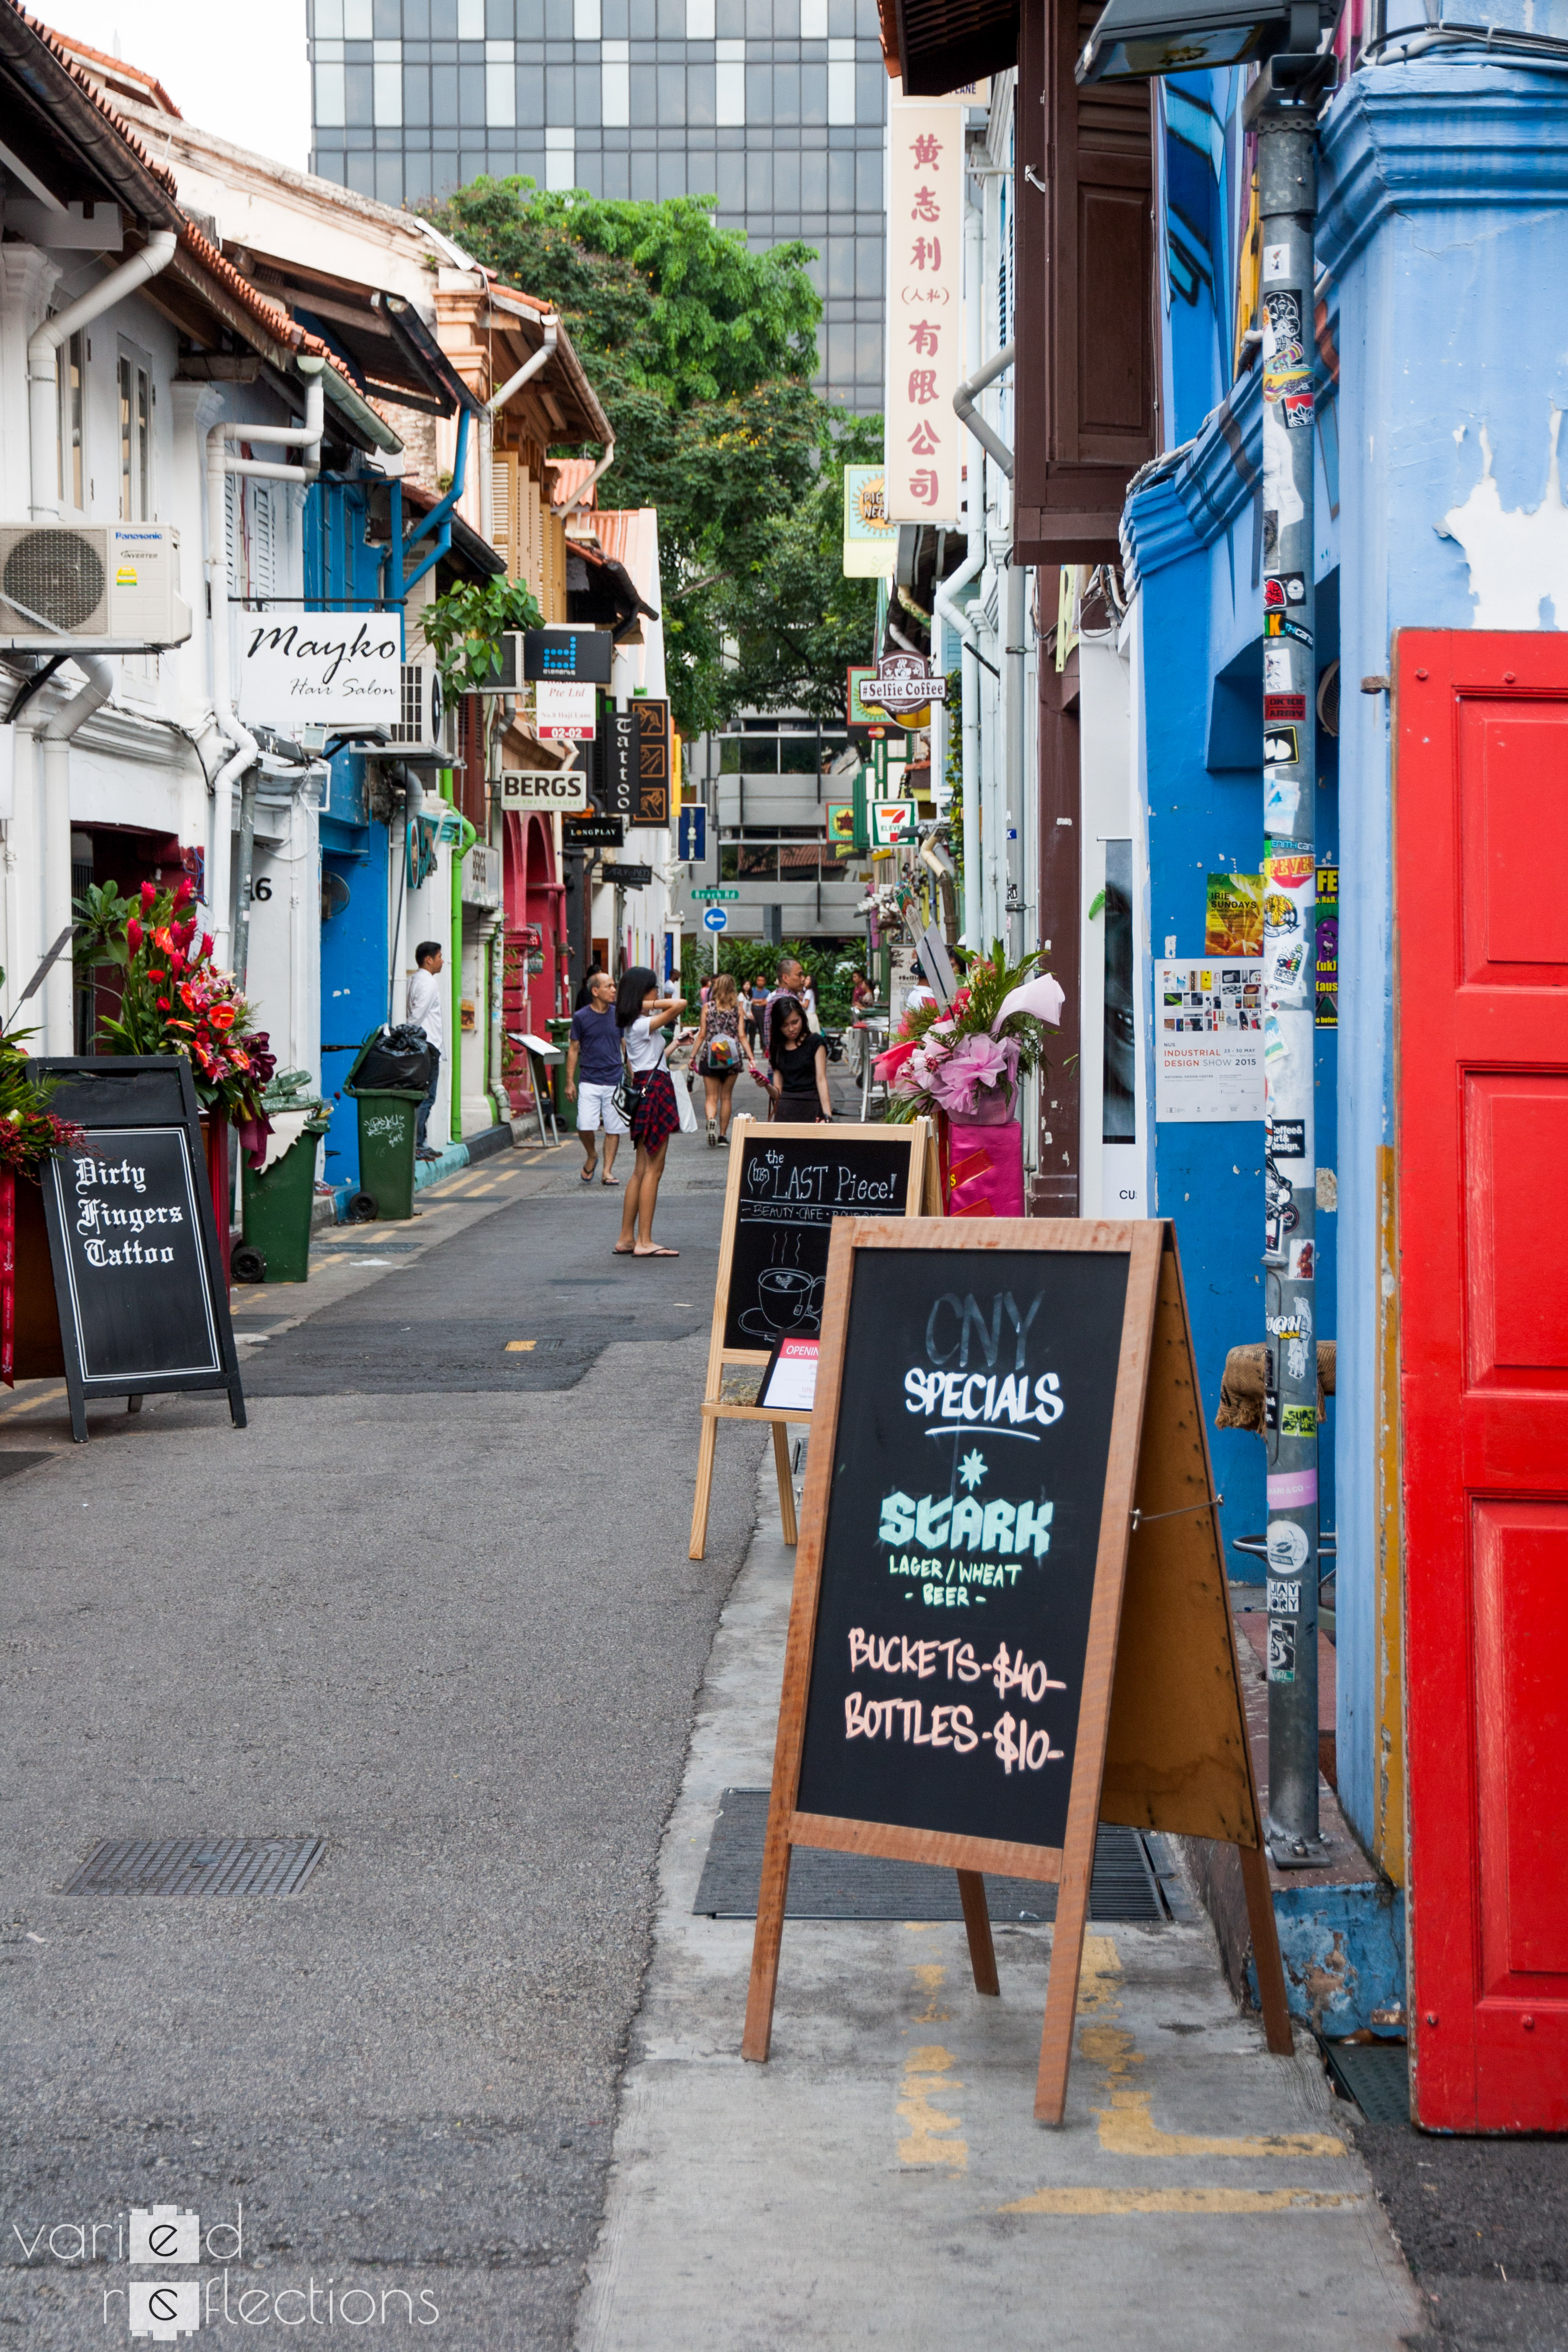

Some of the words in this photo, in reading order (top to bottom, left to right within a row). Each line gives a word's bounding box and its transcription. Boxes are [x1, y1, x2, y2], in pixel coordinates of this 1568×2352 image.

[863, 491, 884, 504] PIE
[247, 623, 396, 684] Mayko
[290, 677, 334, 695] Hair
[342, 678, 396, 697] Salon
[549, 689, 565, 697] Pte
[569, 689, 585, 697] Ltd
[863, 683, 903, 696] #Selfie
[906, 682, 943, 696] Coffee
[552, 728, 582, 738] 02-02
[614, 717, 632, 809] Tattoo
[504, 777, 581, 796] BERGS
[1317, 870, 1339, 891] FE
[695, 890, 721, 899] Beach
[725, 890, 736, 899] Rd
[765, 1150, 785, 1164] the
[72, 1157, 146, 1195] Dirty
[772, 1165, 828, 1201] LAST
[835, 1166, 897, 1201] Piece!
[1119, 1190, 1137, 1200] CU
[76, 1199, 184, 1235] Fingers
[751, 1204, 794, 1218] BEAUTY
[798, 1207, 824, 1220] CAFE
[84, 1238, 175, 1267] Tattoo
[926, 1290, 1044, 1370] CNY
[904, 1368, 1063, 1424] SPECIALS
[1292, 1485, 1304, 1493] CO
[879, 1491, 1054, 1558] STARK
[923, 1583, 970, 1607] BEER
